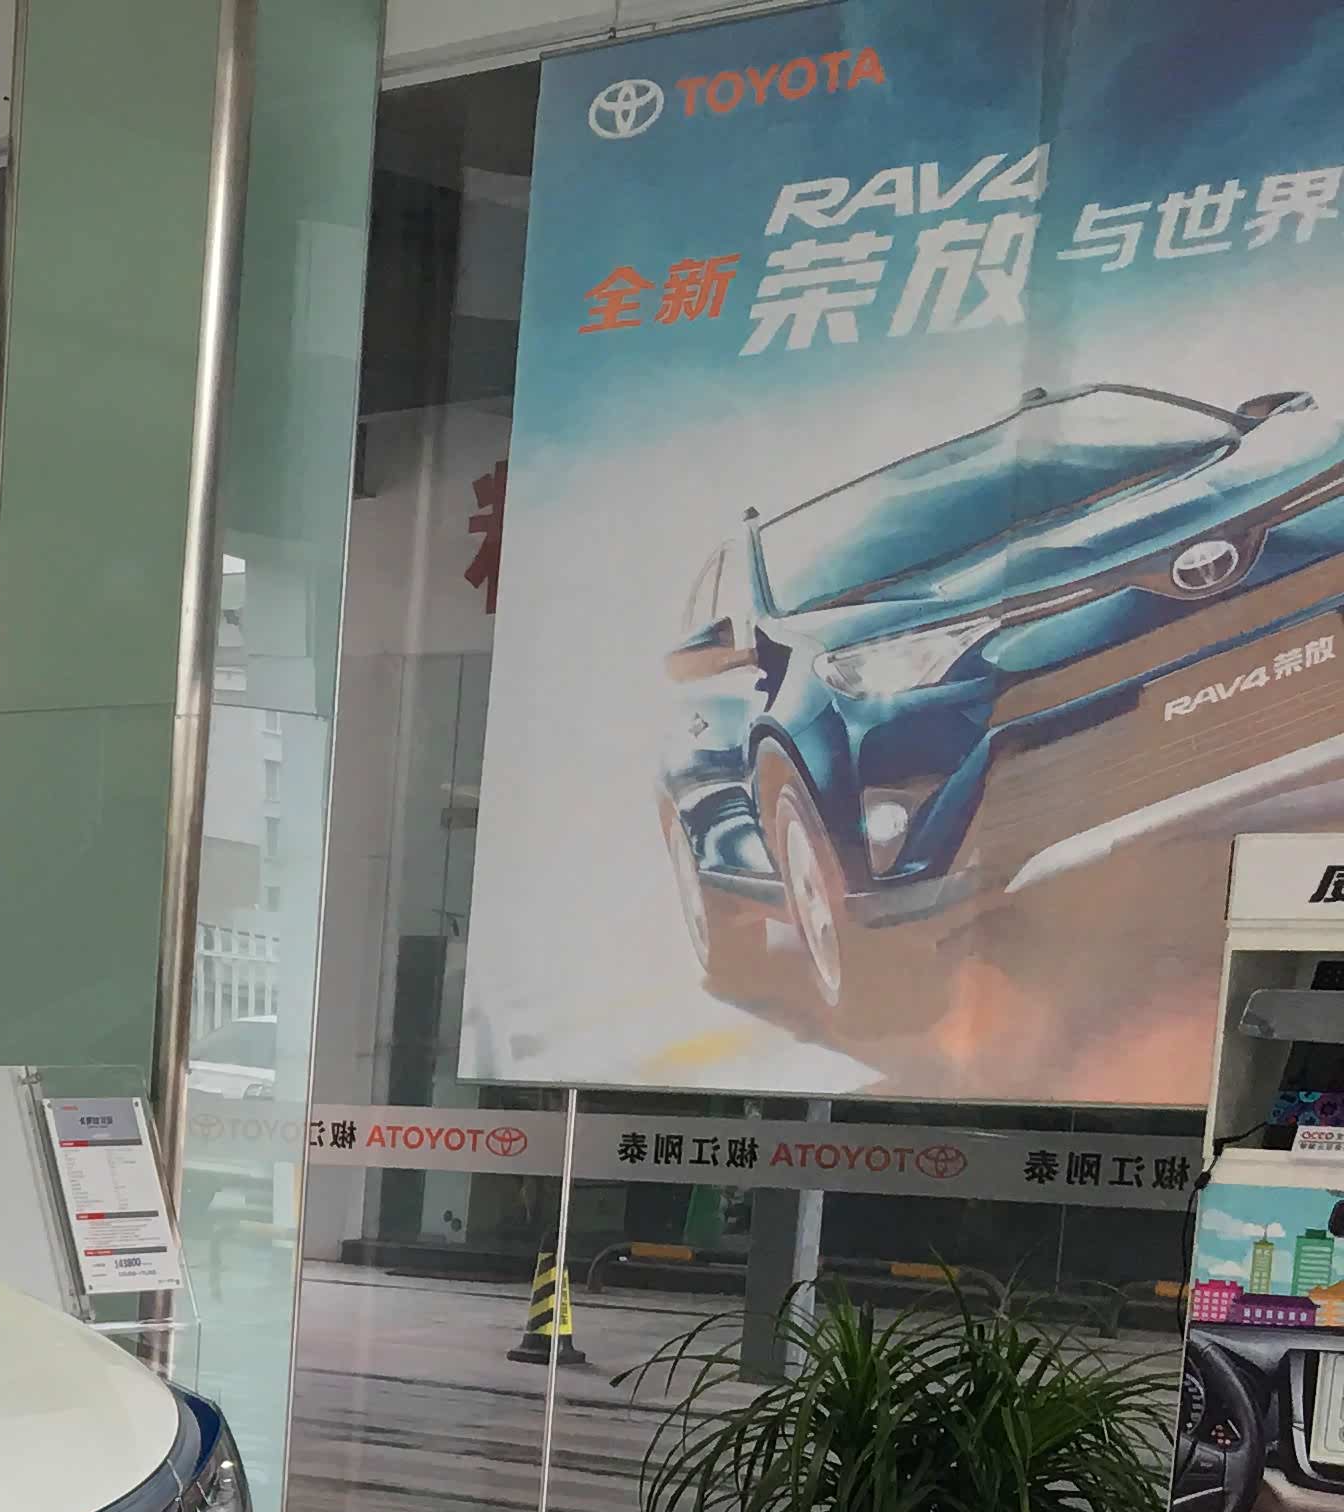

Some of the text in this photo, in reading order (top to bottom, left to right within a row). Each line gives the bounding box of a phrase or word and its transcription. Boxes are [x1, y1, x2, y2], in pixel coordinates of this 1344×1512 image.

[675, 47, 887, 118] TOYOTA
[764, 143, 1052, 236] RAV4
[578, 165, 1344, 357] 全新 荣放 与世界
[1164, 635, 1337, 722] RAV4 荣放
